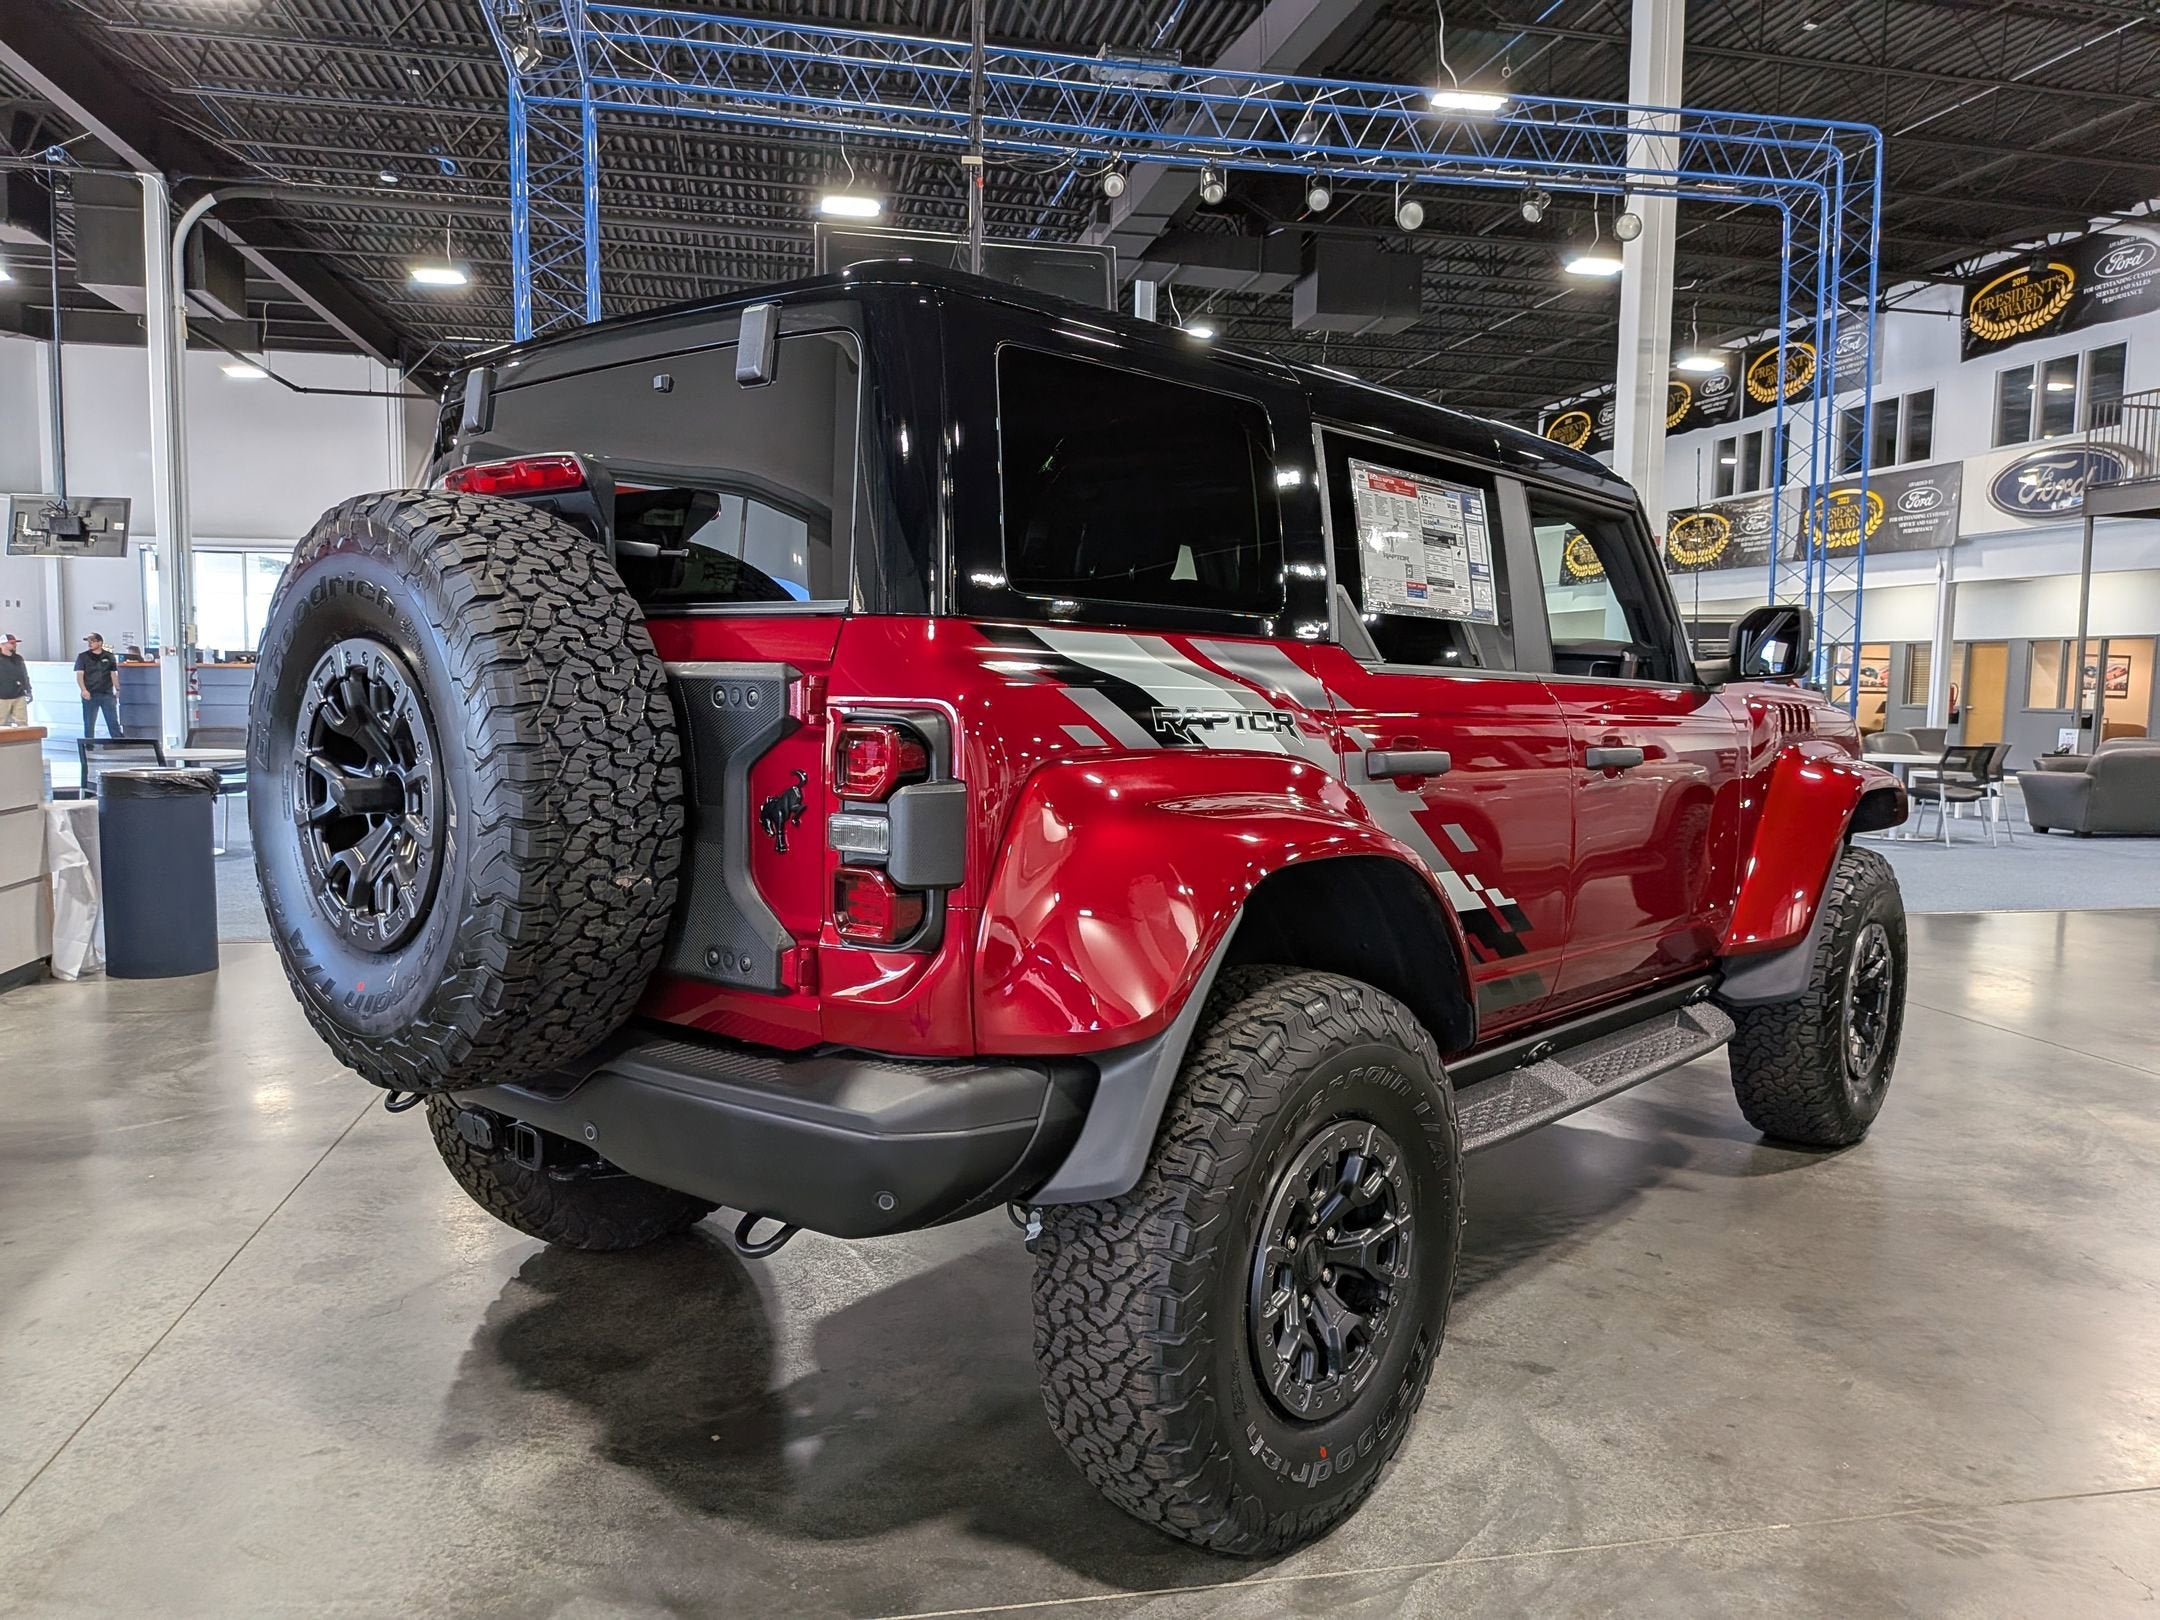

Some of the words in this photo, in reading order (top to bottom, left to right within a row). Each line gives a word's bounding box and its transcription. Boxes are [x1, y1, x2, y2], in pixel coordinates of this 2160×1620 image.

[2104, 247, 2145, 275] Ford
[1977, 274, 2065, 313] PRESIDENT'S
[2083, 287, 2094, 295] FOR
[2094, 276, 2132, 291] OUTSTANDING
[2095, 286, 2119, 299] SERVICE
[2131, 278, 2151, 290] SALES
[1996, 295, 2044, 321] AWARD
[1836, 335, 1862, 355] Ford
[1704, 376, 1727, 394] Ford
[2017, 459, 2099, 505] Ford
[1905, 491, 1934, 509] Ford
[1150, 706, 1305, 746] RAPTOR
[288, 927, 337, 1003] T/A
[1245, 1322, 1431, 1488] BFGoodrich
